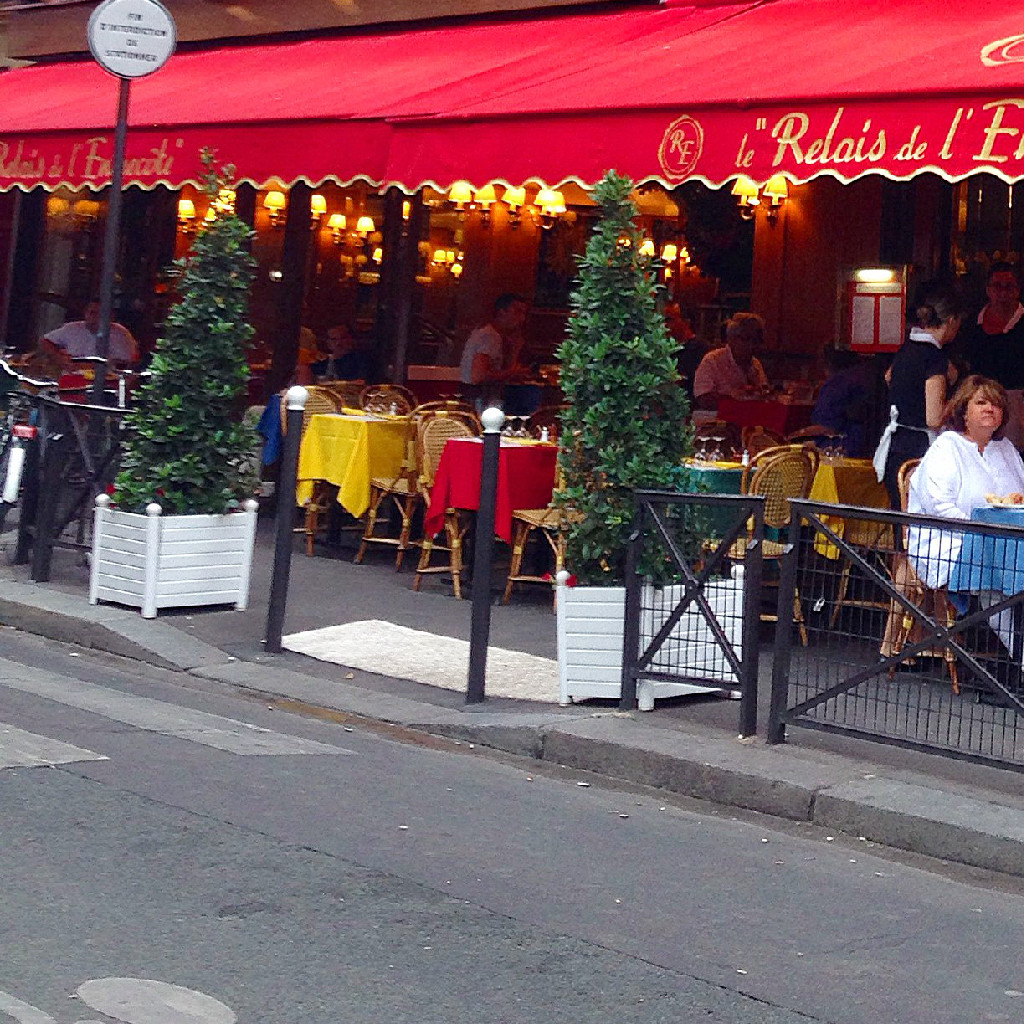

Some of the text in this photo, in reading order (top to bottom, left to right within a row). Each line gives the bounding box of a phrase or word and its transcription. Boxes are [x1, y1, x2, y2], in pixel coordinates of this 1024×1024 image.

[669, 128, 696, 165] RE
[734, 133, 755, 168] le
[893, 125, 928, 160] de
